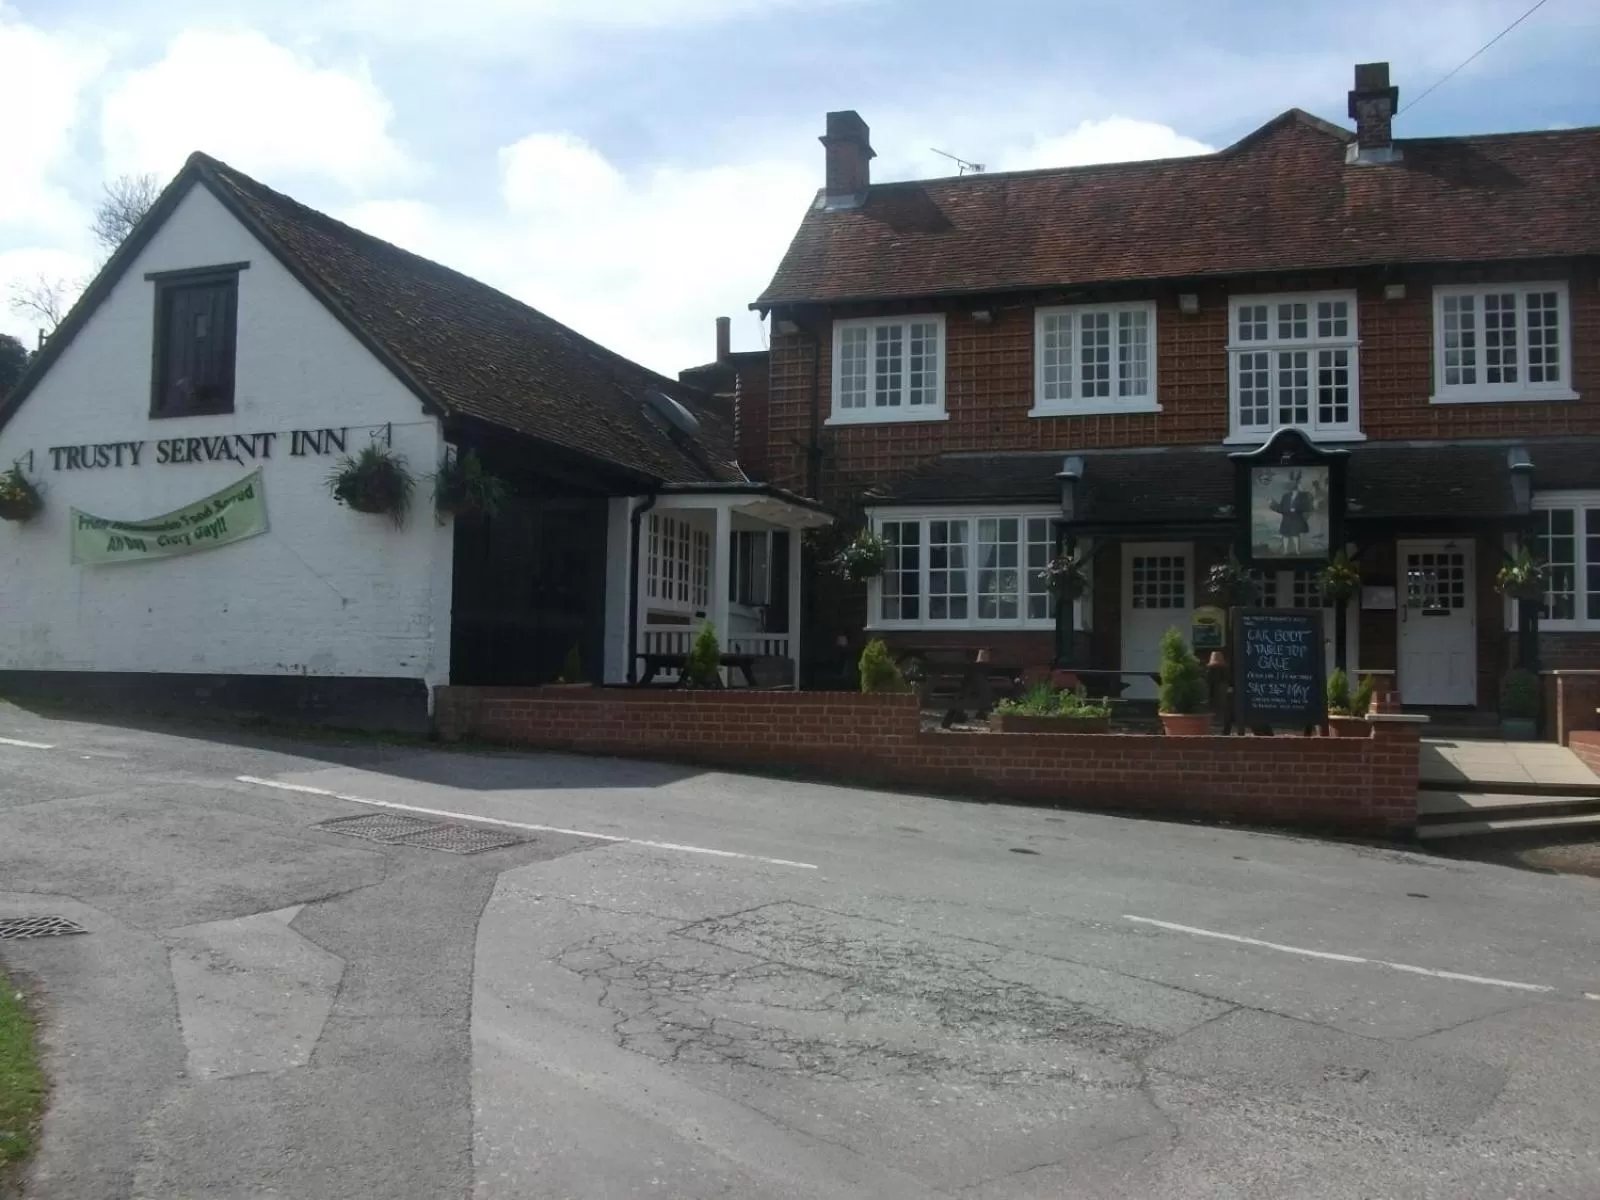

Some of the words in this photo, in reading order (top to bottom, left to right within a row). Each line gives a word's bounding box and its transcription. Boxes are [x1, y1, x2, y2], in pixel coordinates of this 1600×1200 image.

[49, 440, 144, 470] TRUSTY
[156, 432, 276, 465] SERVANT
[290, 427, 349, 456] INN
[1247, 628, 1276, 644] CAR
[1275, 628, 1312, 642] BOOT
